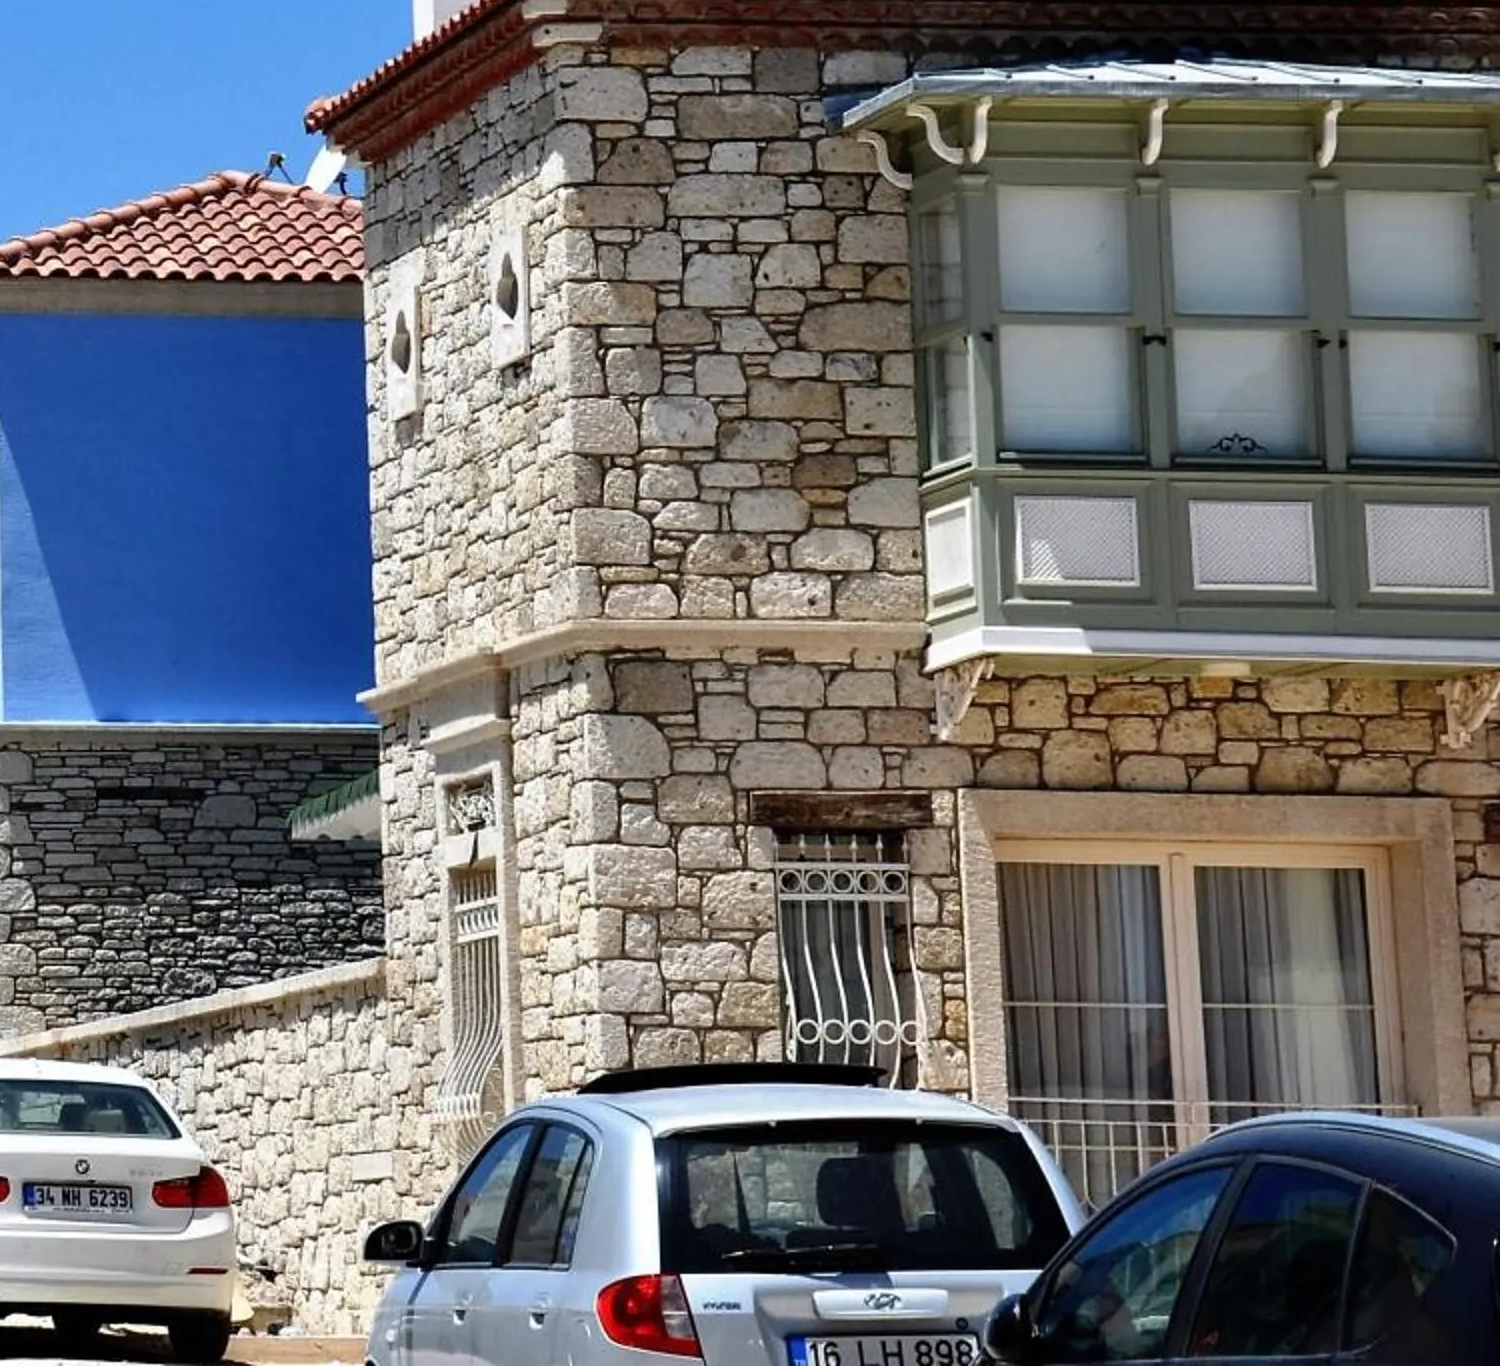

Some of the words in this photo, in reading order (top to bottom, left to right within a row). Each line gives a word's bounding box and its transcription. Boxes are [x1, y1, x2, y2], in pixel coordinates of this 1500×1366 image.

[35, 1187, 54, 1205] 34
[62, 1188, 80, 1206] NH
[89, 1189, 128, 1207] 6239
[810, 1340, 840, 1366] 16
[857, 1340, 903, 1366] LH
[914, 1339, 974, 1366] 898
